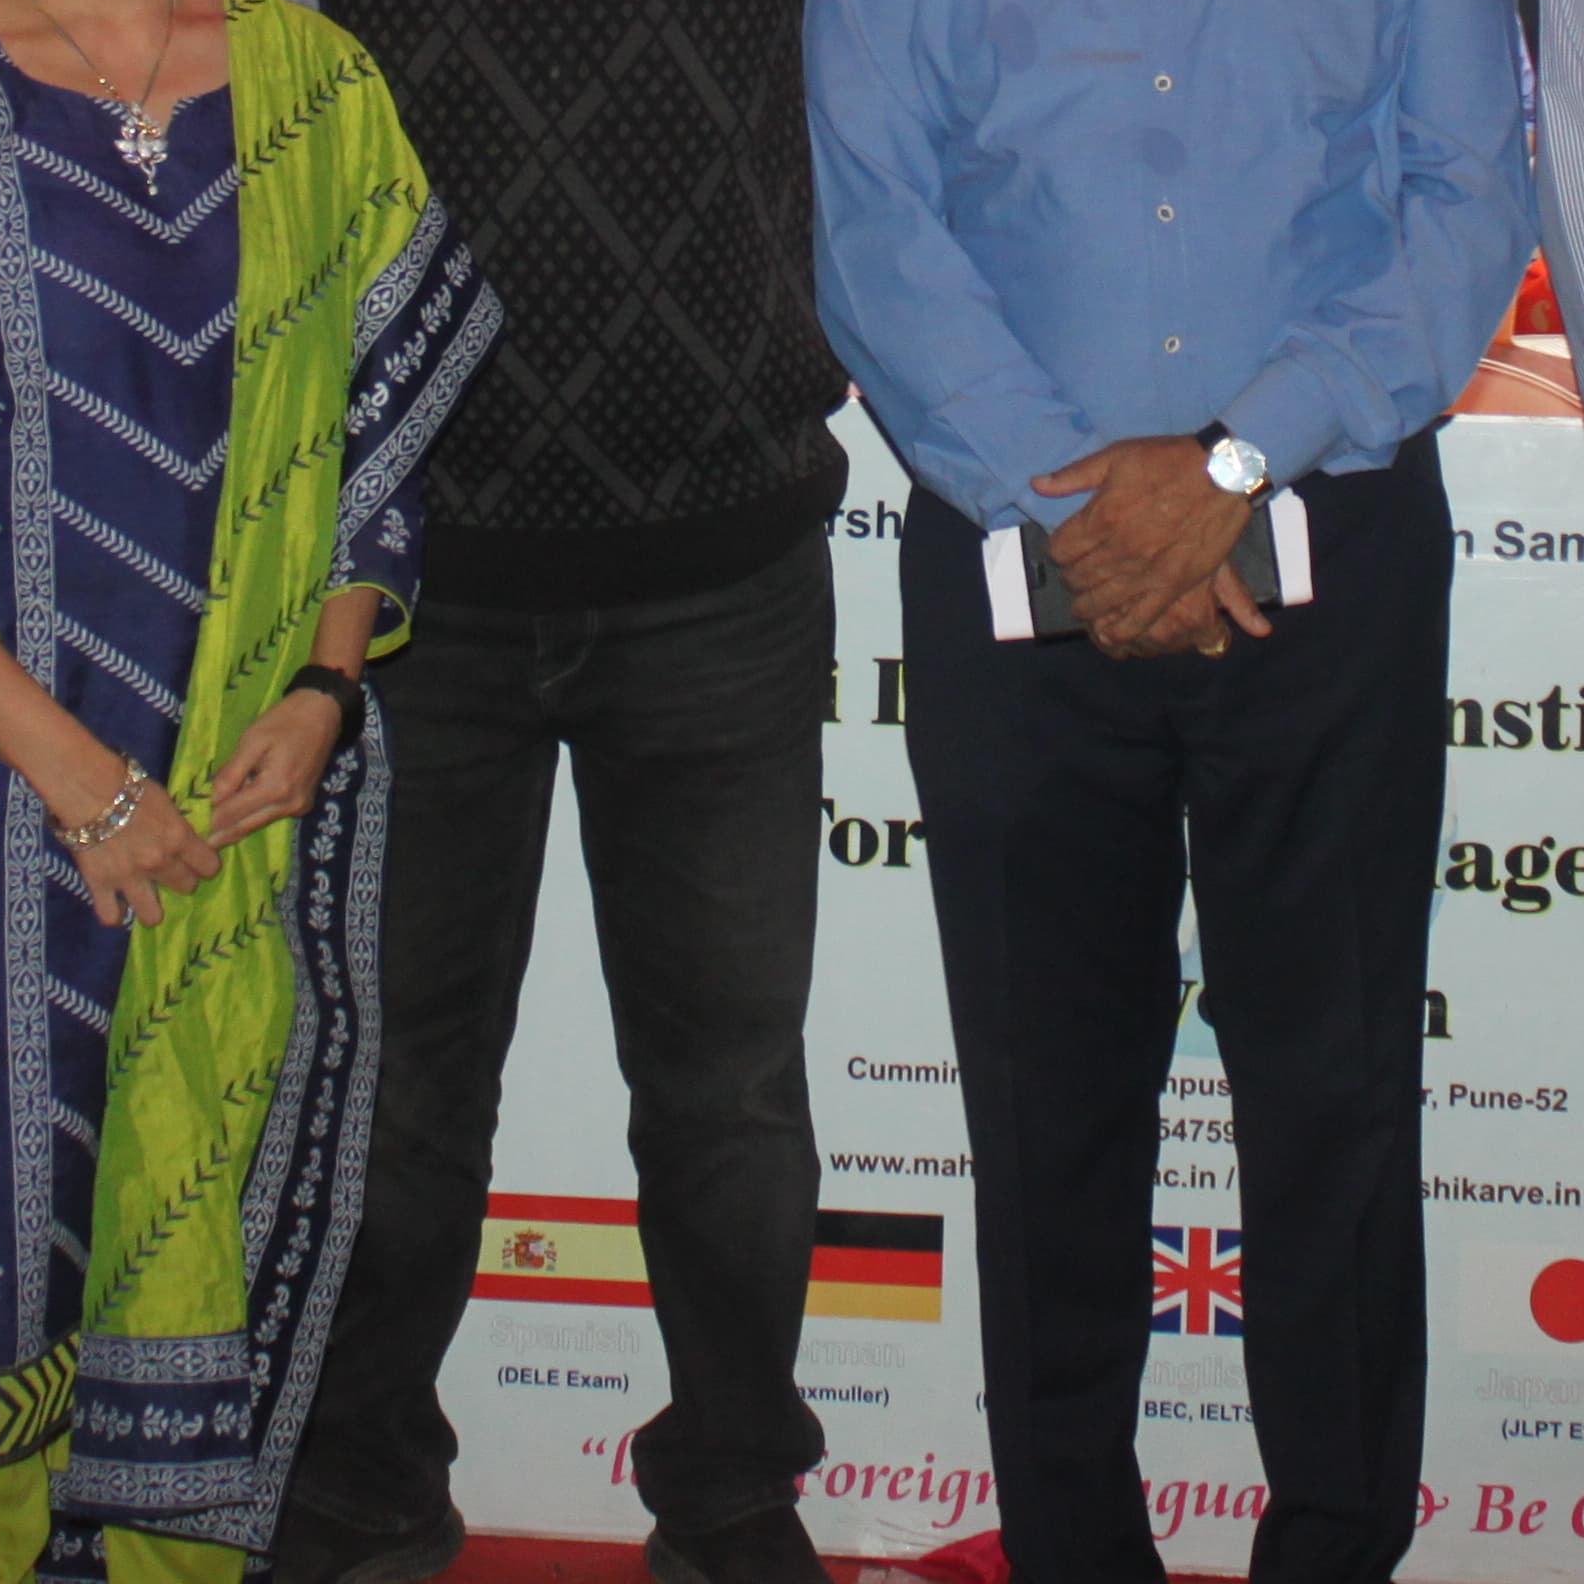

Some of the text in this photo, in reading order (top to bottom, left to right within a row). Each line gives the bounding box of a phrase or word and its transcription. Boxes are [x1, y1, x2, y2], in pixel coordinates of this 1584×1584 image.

[1449, 1084, 1568, 1112] Pune-52
[830, 1153, 974, 1178] www.mah
[1421, 1176, 1581, 1206] shikarve.in
[497, 1367, 559, 1388] (DELE
[567, 1370, 629, 1392] Exam)
[797, 1385, 890, 1408] axmuller)
[1501, 1418, 1563, 1440] (JLPT
[1470, 1483, 1548, 1536] Be
